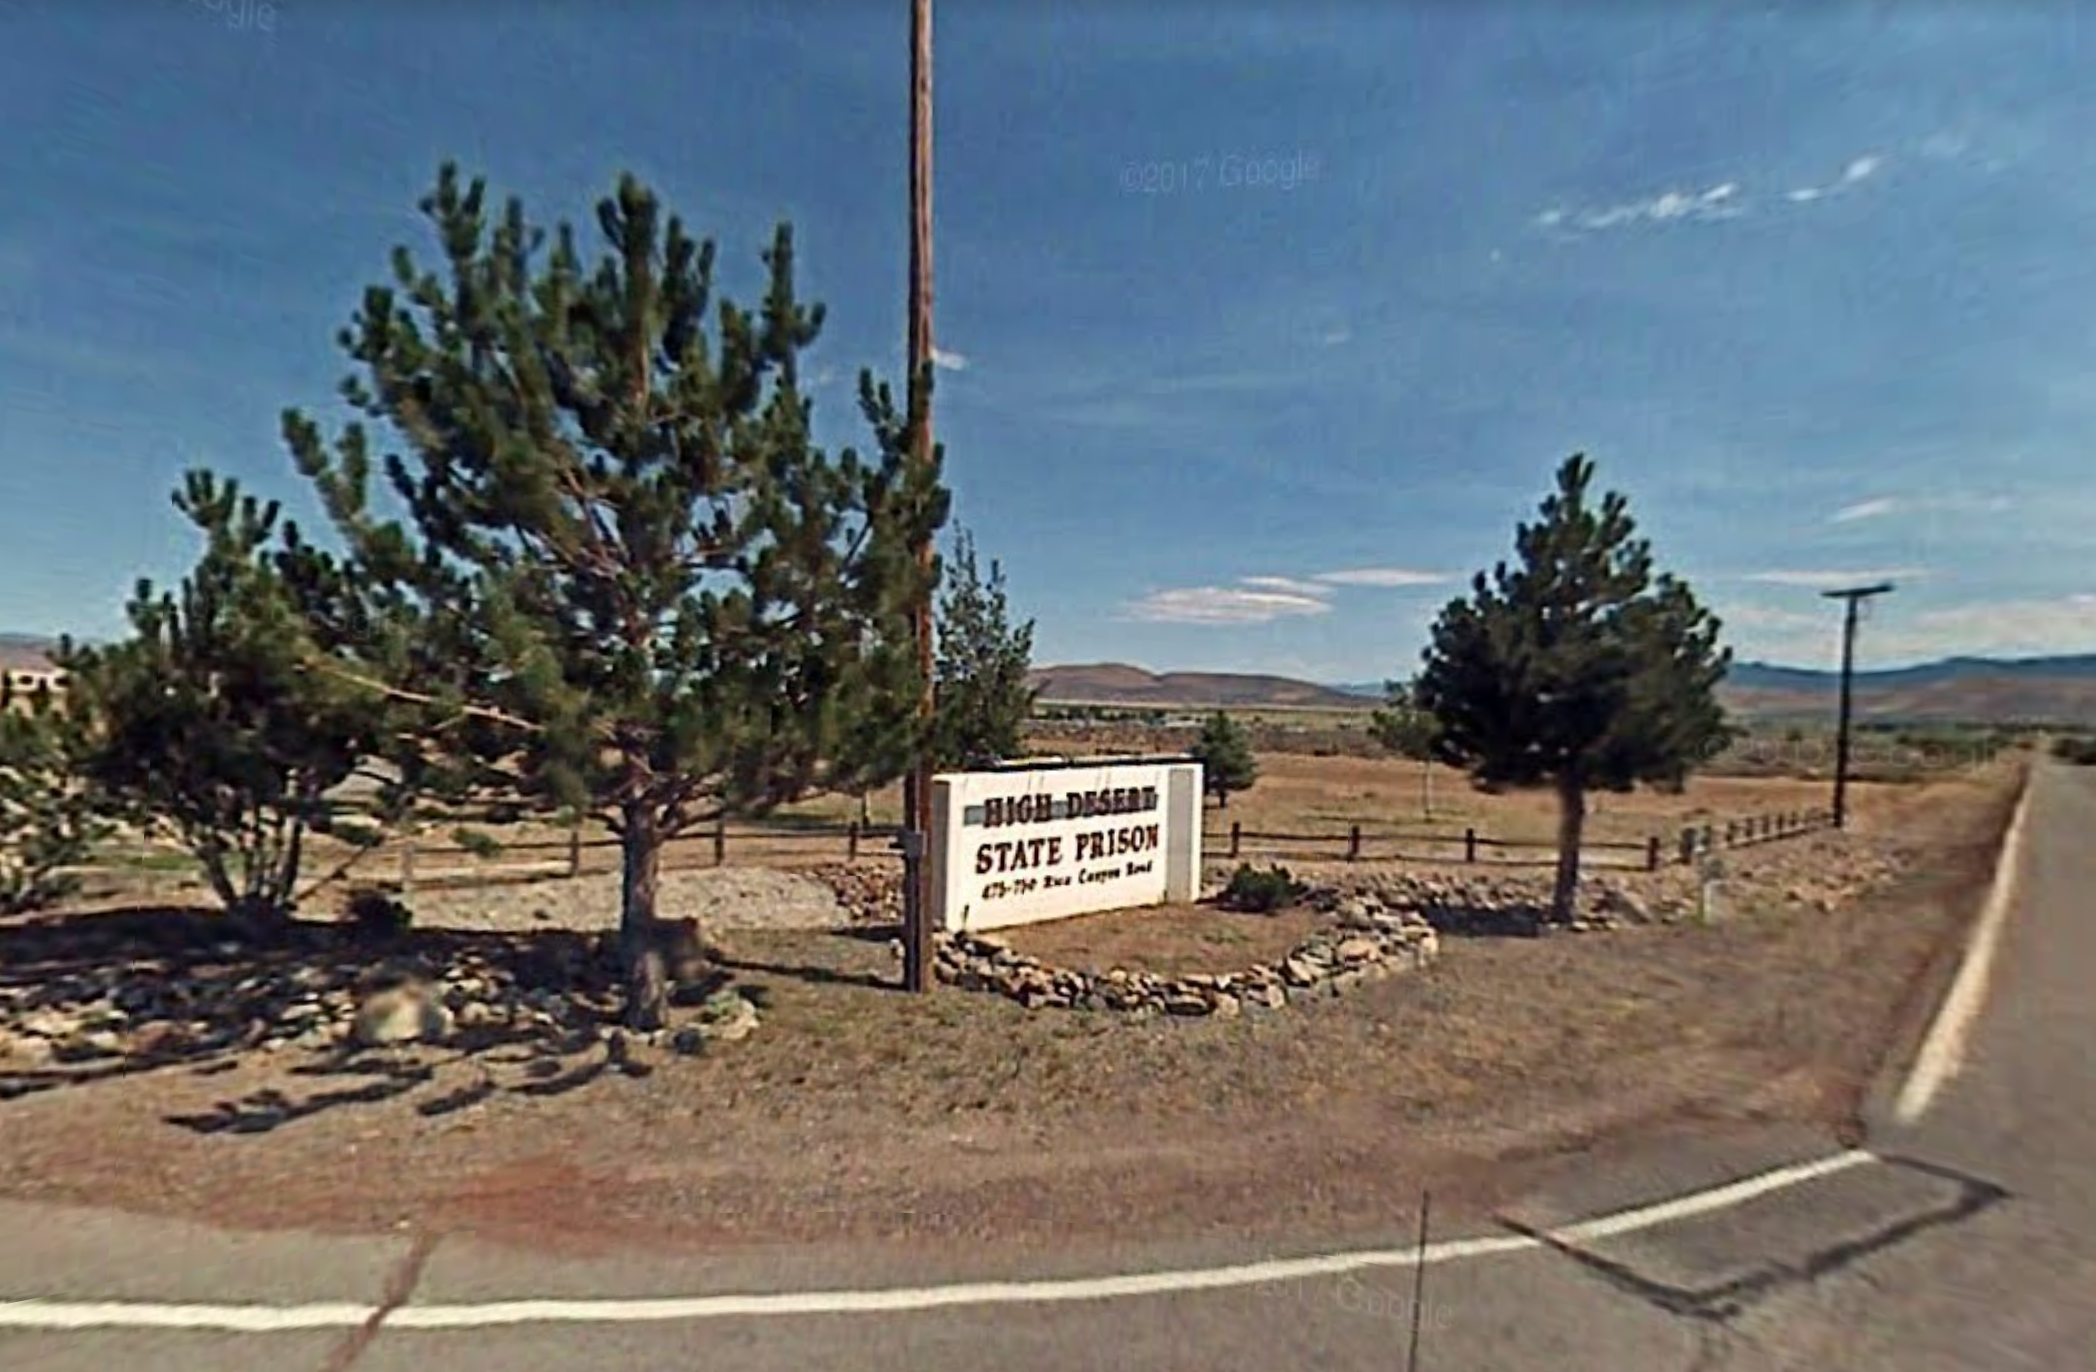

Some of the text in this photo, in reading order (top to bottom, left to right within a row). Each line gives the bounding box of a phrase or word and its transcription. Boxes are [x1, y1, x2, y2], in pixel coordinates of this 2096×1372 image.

[984, 786, 1156, 828] HIGH DESERT
[976, 823, 1158, 874] STATE PRISON
